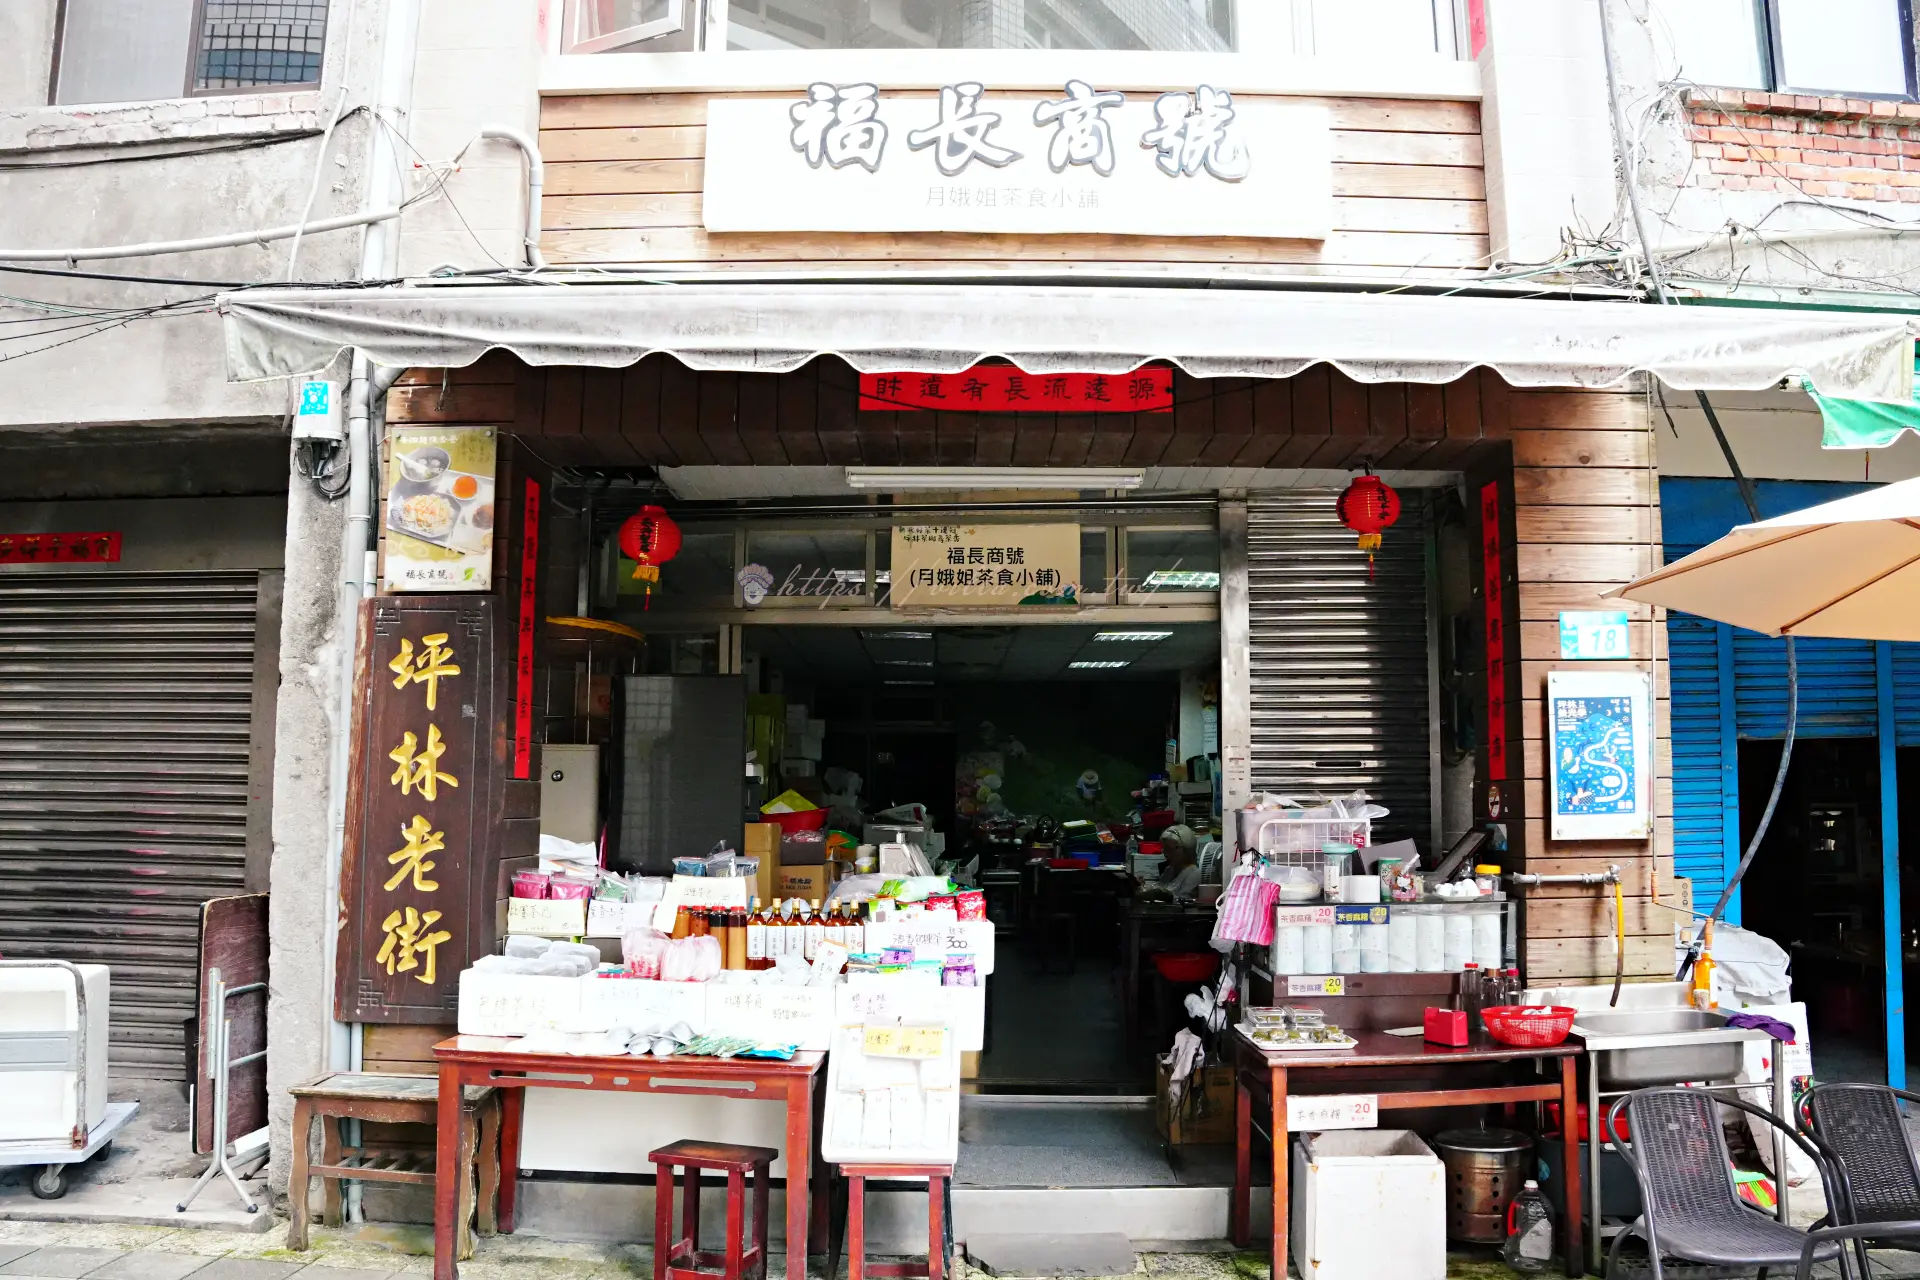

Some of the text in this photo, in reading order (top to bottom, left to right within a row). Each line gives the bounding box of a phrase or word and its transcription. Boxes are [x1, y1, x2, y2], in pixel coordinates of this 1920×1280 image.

[788, 79, 1254, 182] 福長商號
[924, 185, 1101, 209] 月娥姐茶食小舖
[947, 547, 1025, 565] 福長商號
[405, 567, 449, 580] 福長商號
[910, 568, 1062, 588] (月娥姐茶食小舖)
[375, 632, 462, 985] 坪林老街
[1318, 908, 1331, 917] 20
[1375, 907, 1387, 916] 20
[945, 935, 968, 949] 300
[1328, 978, 1341, 987] 20
[1355, 1103, 1371, 1114] 20
